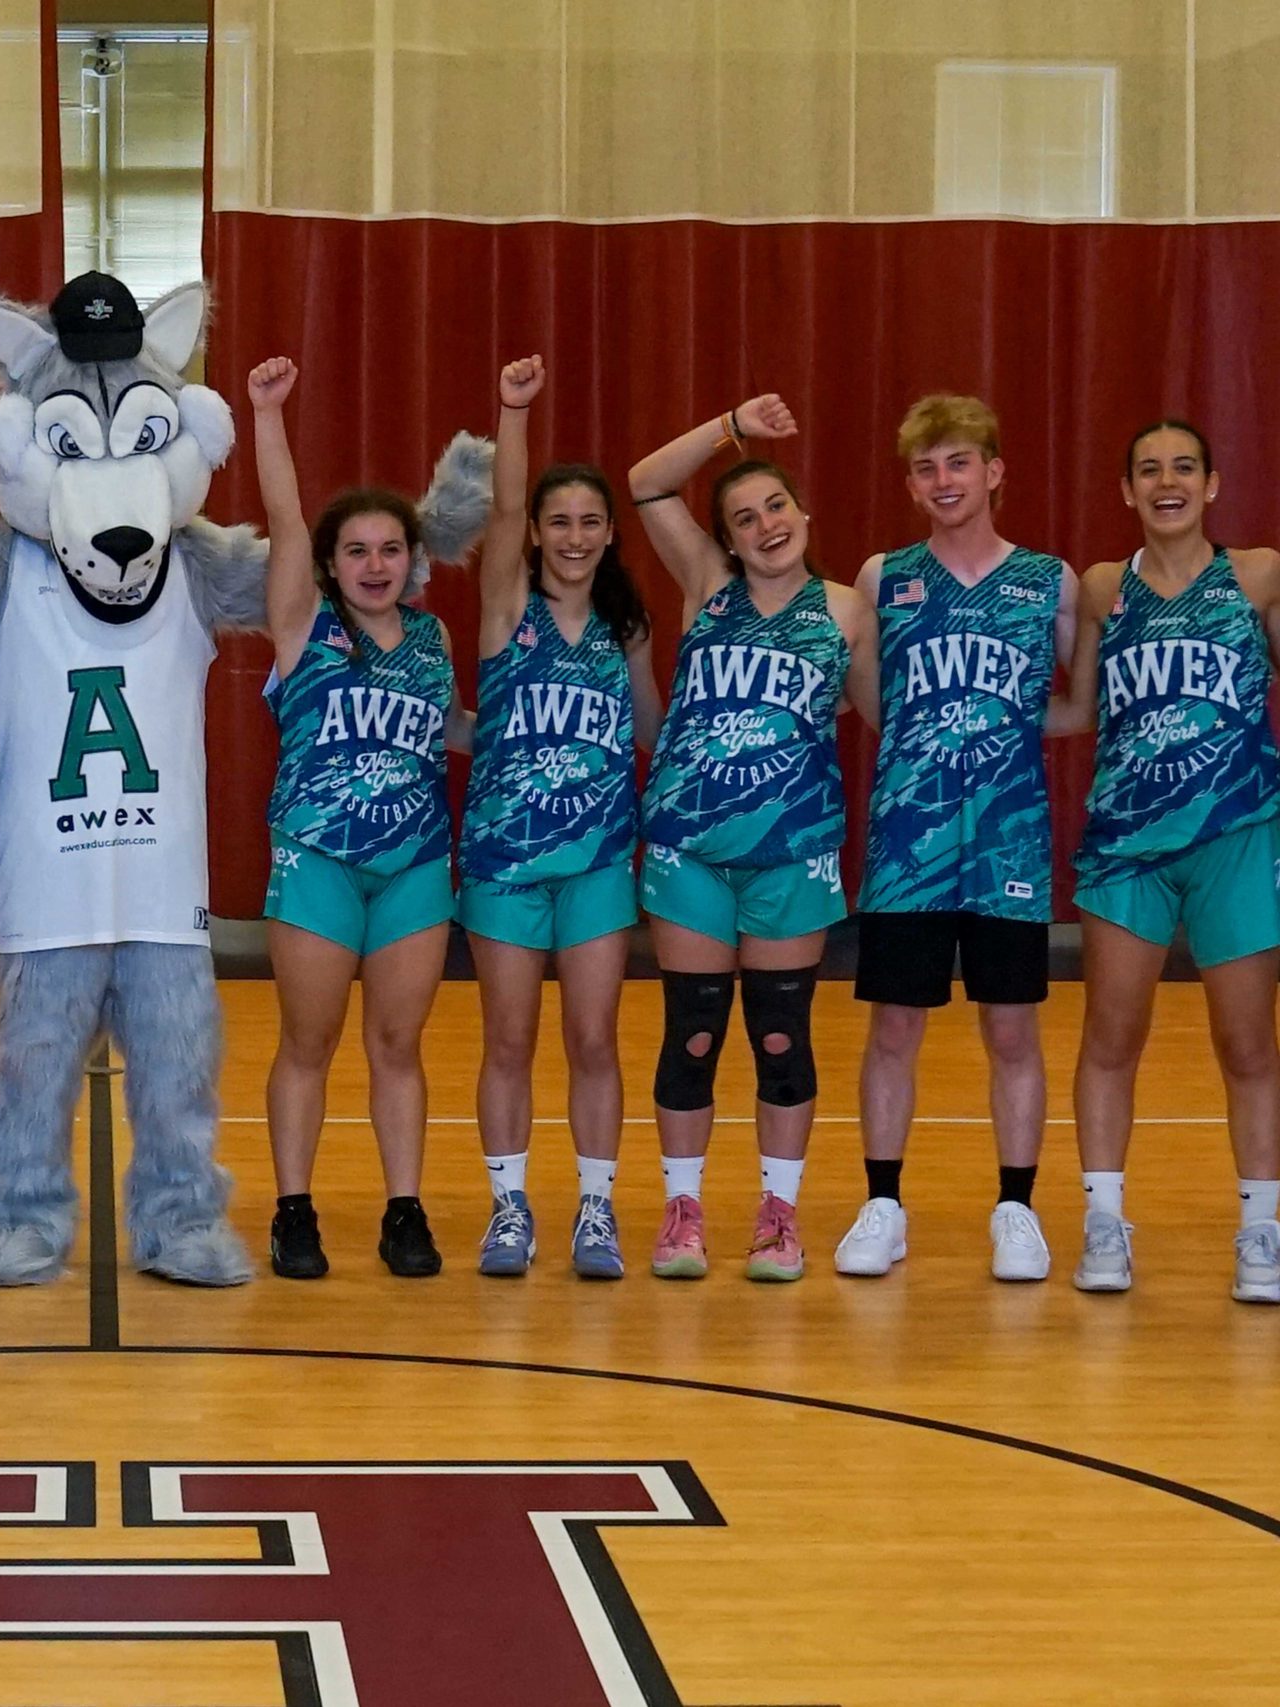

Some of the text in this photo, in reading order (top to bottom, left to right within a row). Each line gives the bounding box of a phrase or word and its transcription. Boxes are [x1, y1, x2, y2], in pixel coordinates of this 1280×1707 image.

[682, 644, 825, 726] AWEX
[904, 632, 1031, 709] AWEX
[1105, 638, 1242, 718] AWEX
[48, 665, 159, 802] A
[503, 682, 622, 756] AWEX
[709, 708, 767, 737] New
[1137, 704, 1187, 738] New
[720, 728, 777, 758] York
[1147, 722, 1199, 755] York
[355, 749, 403, 777] New
[535, 744, 579, 770] New
[687, 738, 794, 786] BASKETBALL
[364, 769, 414, 797] York
[544, 763, 590, 789] York
[330, 776, 431, 824] BASKETBALL
[56, 808, 155, 833] awex
